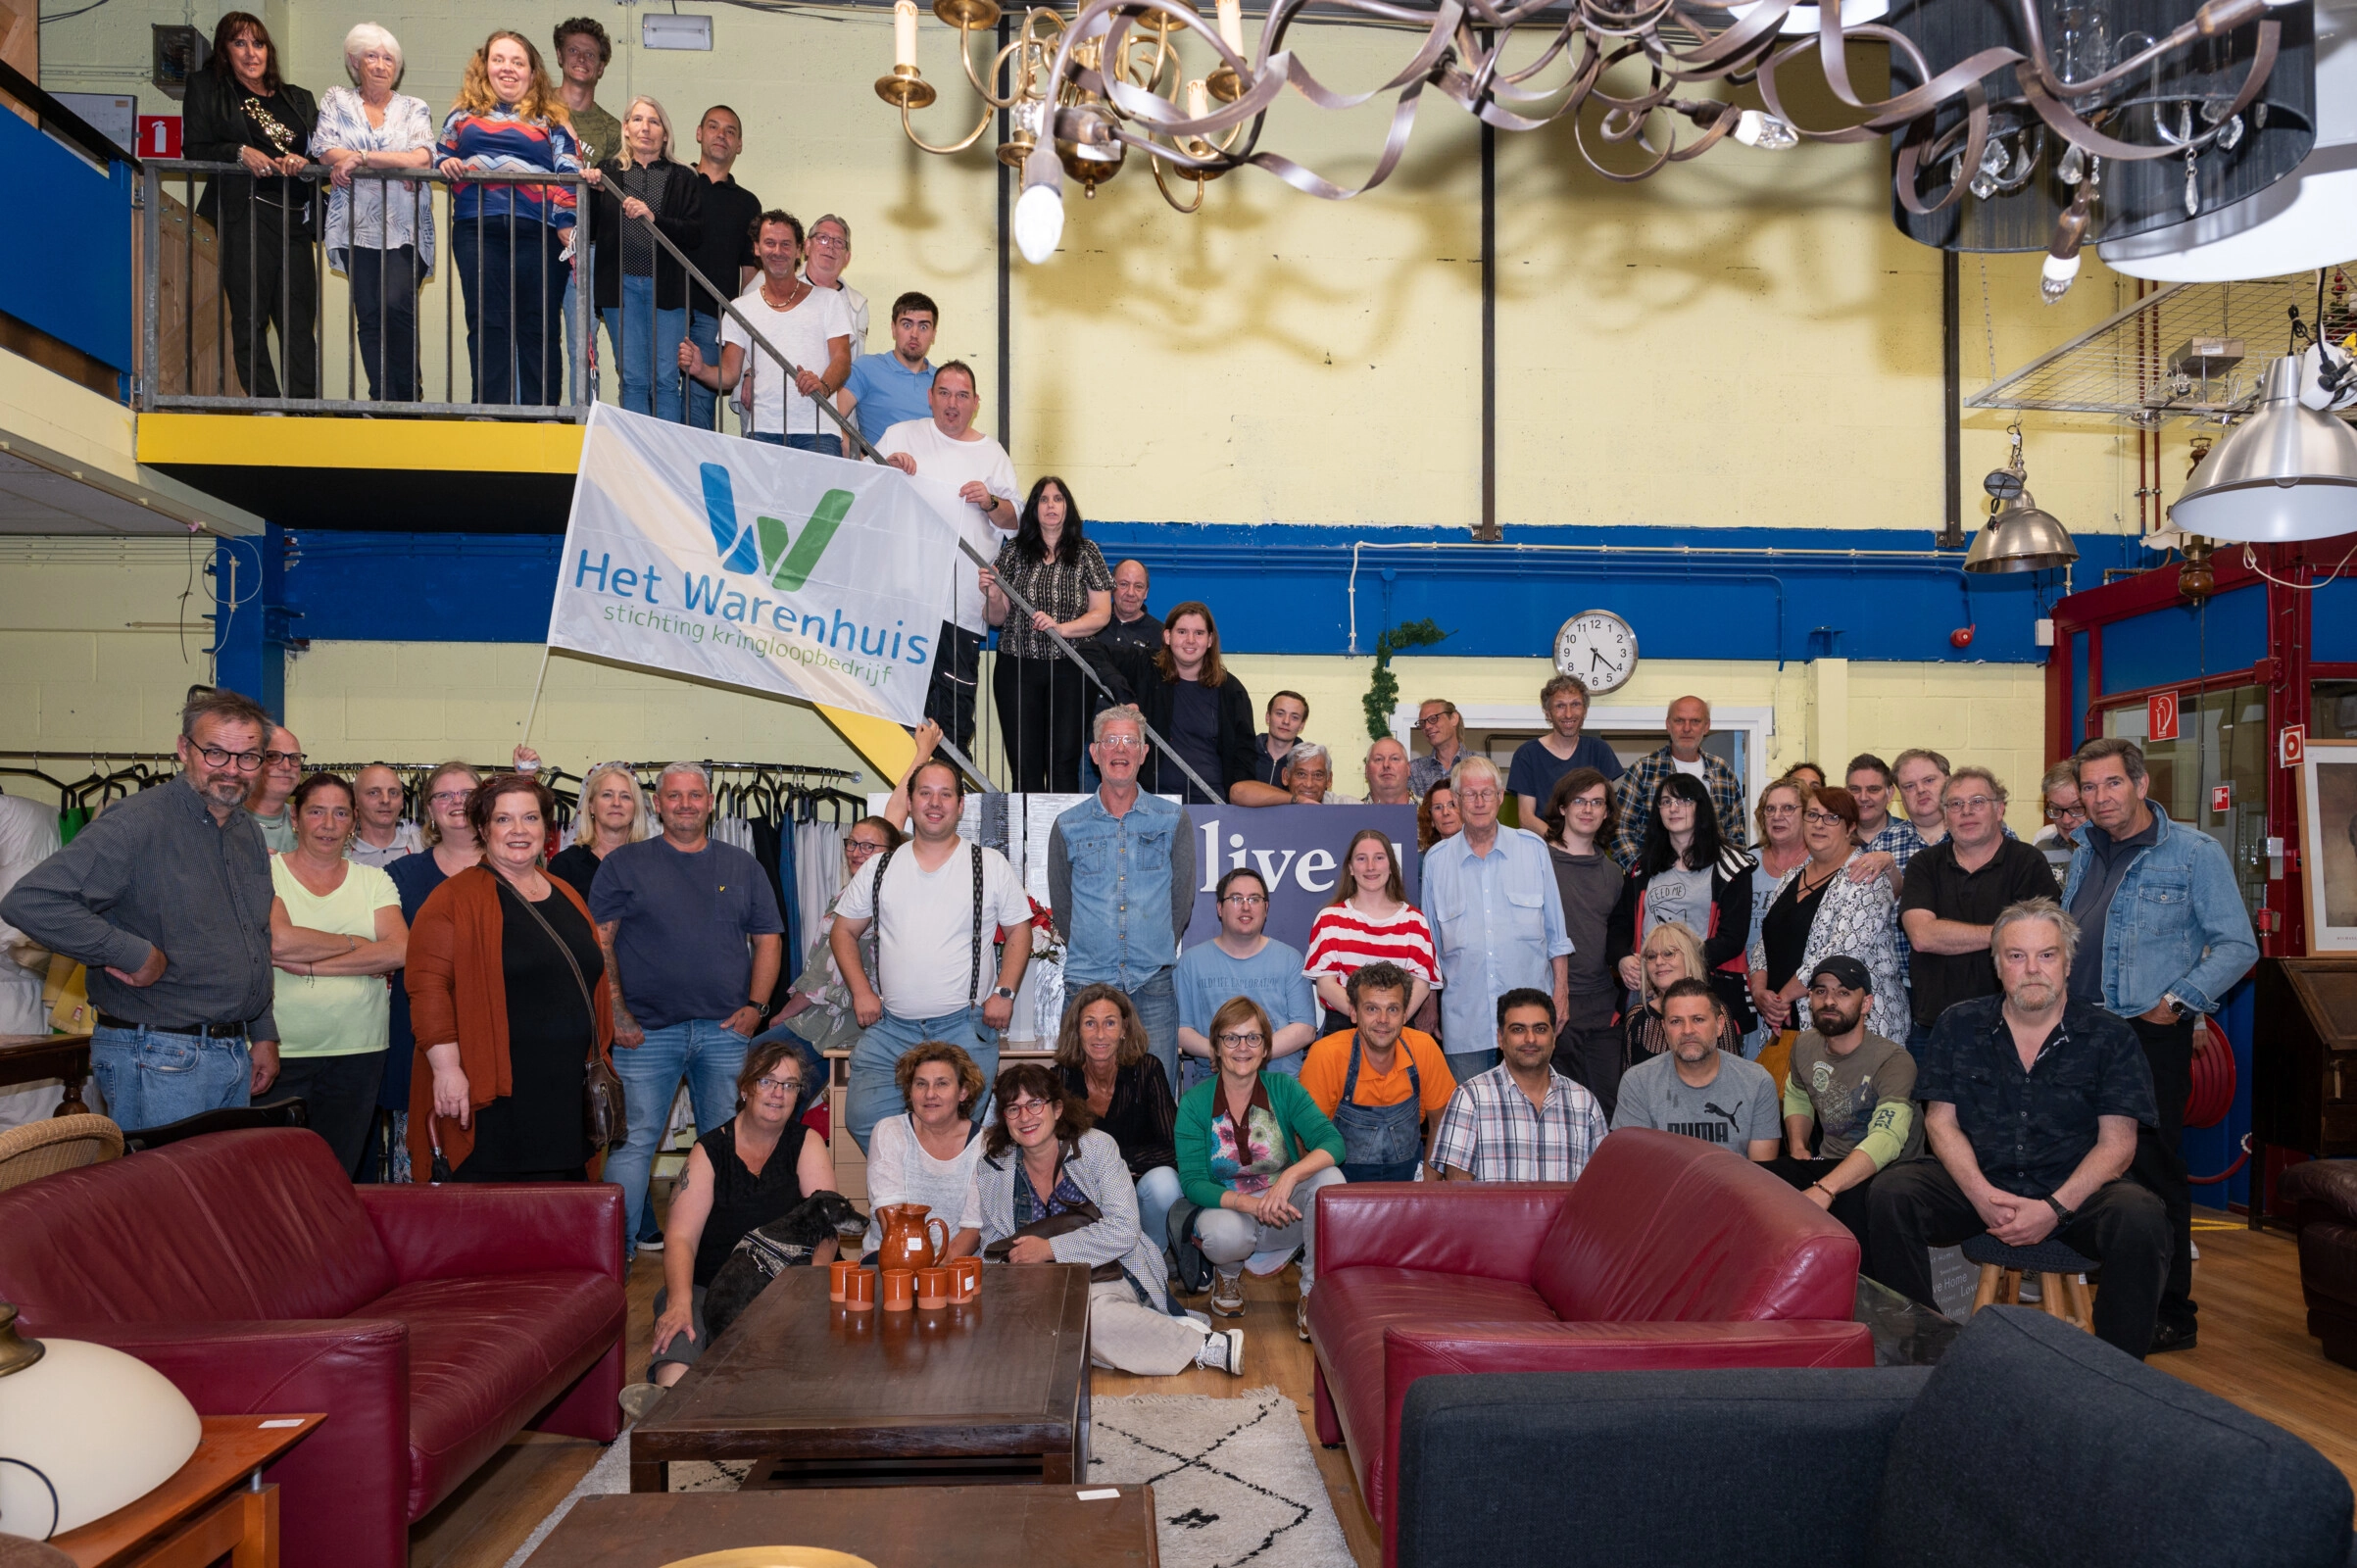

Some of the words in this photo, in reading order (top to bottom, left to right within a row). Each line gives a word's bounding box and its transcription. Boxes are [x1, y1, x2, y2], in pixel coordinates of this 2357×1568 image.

[575, 549, 663, 604] Het
[685, 571, 929, 664] Warenhuis
[1577, 623, 1587, 632] 11
[1590, 619, 1601, 629] 12
[1607, 623, 1612, 633] 1
[1565, 634, 1577, 644] 10
[1616, 634, 1623, 644] 2
[604, 604, 705, 643] stichting
[712, 624, 894, 687] kringloopbedrijf
[1563, 648, 1570, 658] 9
[1620, 648, 1627, 658] 3
[1567, 662, 1574, 671] 8
[1616, 662, 1623, 671] 4
[1578, 672, 1585, 681] 7
[1592, 676, 1598, 686] 6
[1606, 672, 1613, 683] 5
[1200, 819, 1338, 893] live
[1944, 1273, 1967, 1290] Home
